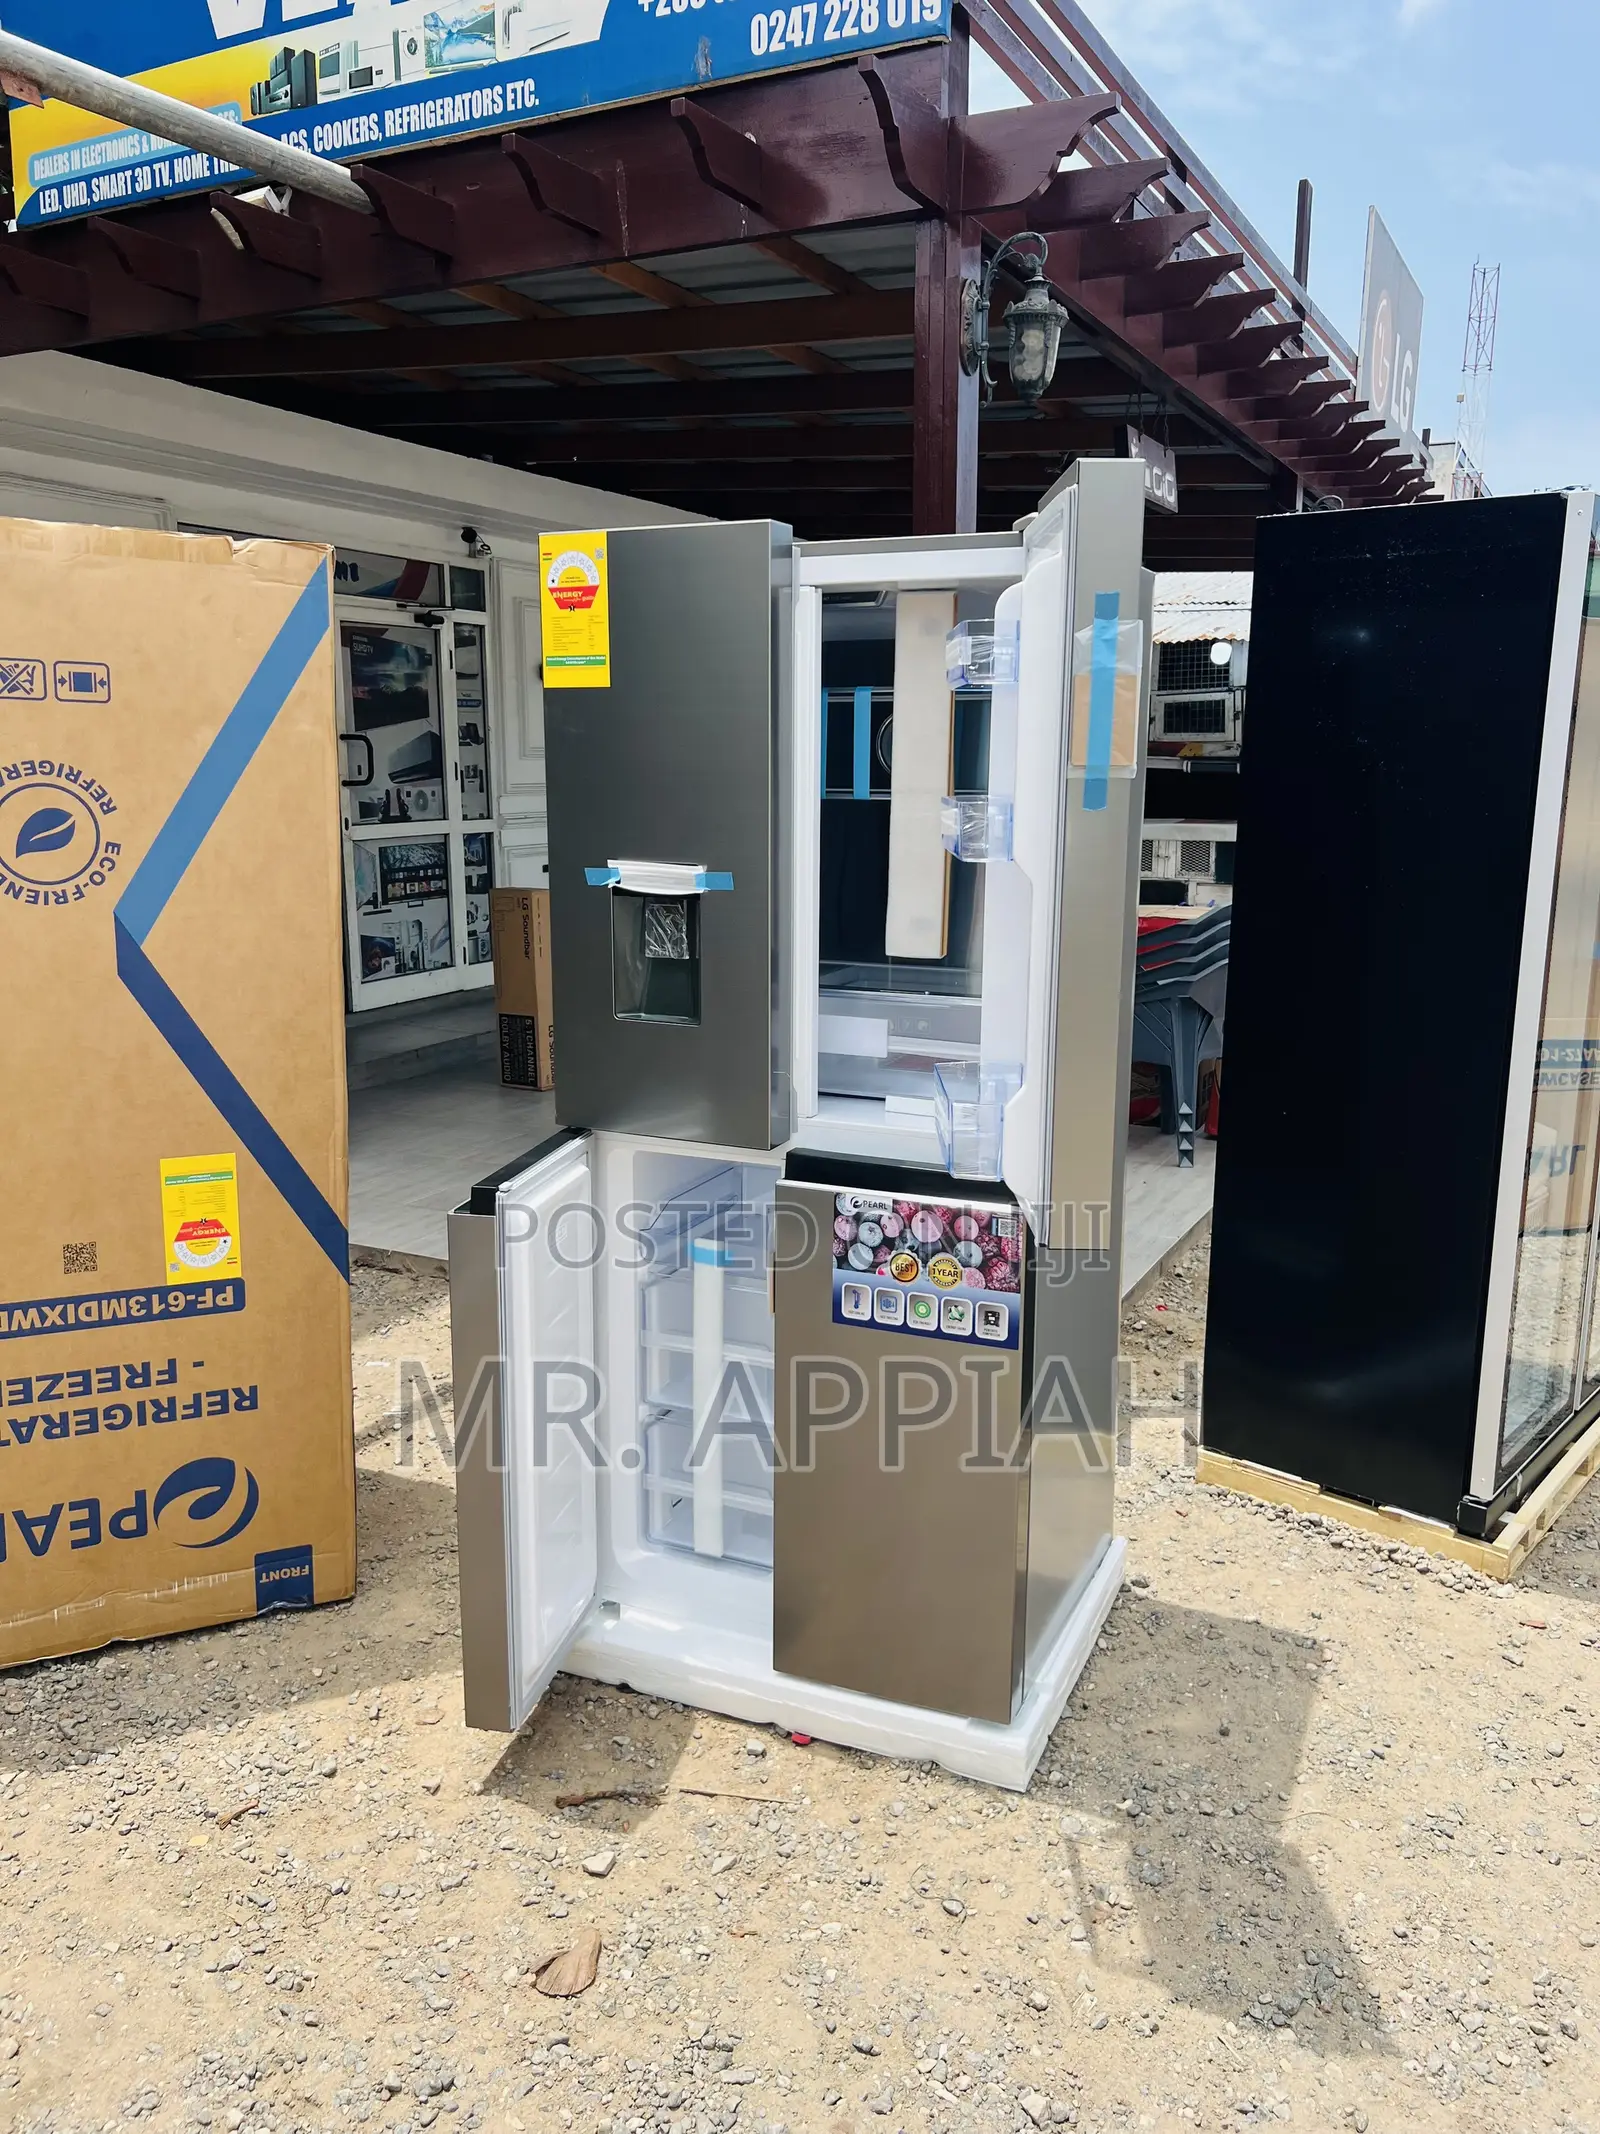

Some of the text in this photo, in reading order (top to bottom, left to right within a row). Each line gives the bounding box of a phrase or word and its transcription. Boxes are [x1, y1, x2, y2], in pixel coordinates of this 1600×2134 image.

[750, 3, 817, 56] 0247
[824, 0, 879, 41] 228
[887, 0, 942, 28] 019
[313, 113, 382, 152] COOKERS,
[384, 85, 503, 137] REFRIGERATORS
[506, 78, 539, 112] ETC.
[34, 151, 70, 180] DEALERS
[70, 149, 81, 171] IN
[81, 133, 140, 168] ELECTRONICS
[142, 135, 149, 154] &
[40, 188, 62, 215] LED,
[62, 180, 91, 209] UHD,
[91, 169, 132, 202] SMART
[135, 166, 151, 193] 3D
[153, 161, 172, 188] TV,
[174, 152, 210, 183] HOME
[1391, 333, 1413, 433] LG
[522, 897, 531, 960] LG Soundbar
[501, 1016, 512, 1081] DOLBY AUDIO
[863, 1200, 889, 1211] PEARL
[895, 1262, 914, 1273] BEST
[937, 1268, 959, 1278] YEAR
[0, 1357, 178, 1408] FREEZE
[0, 1490, 149, 1564] PEA
[260, 1564, 310, 1584] FRONT
